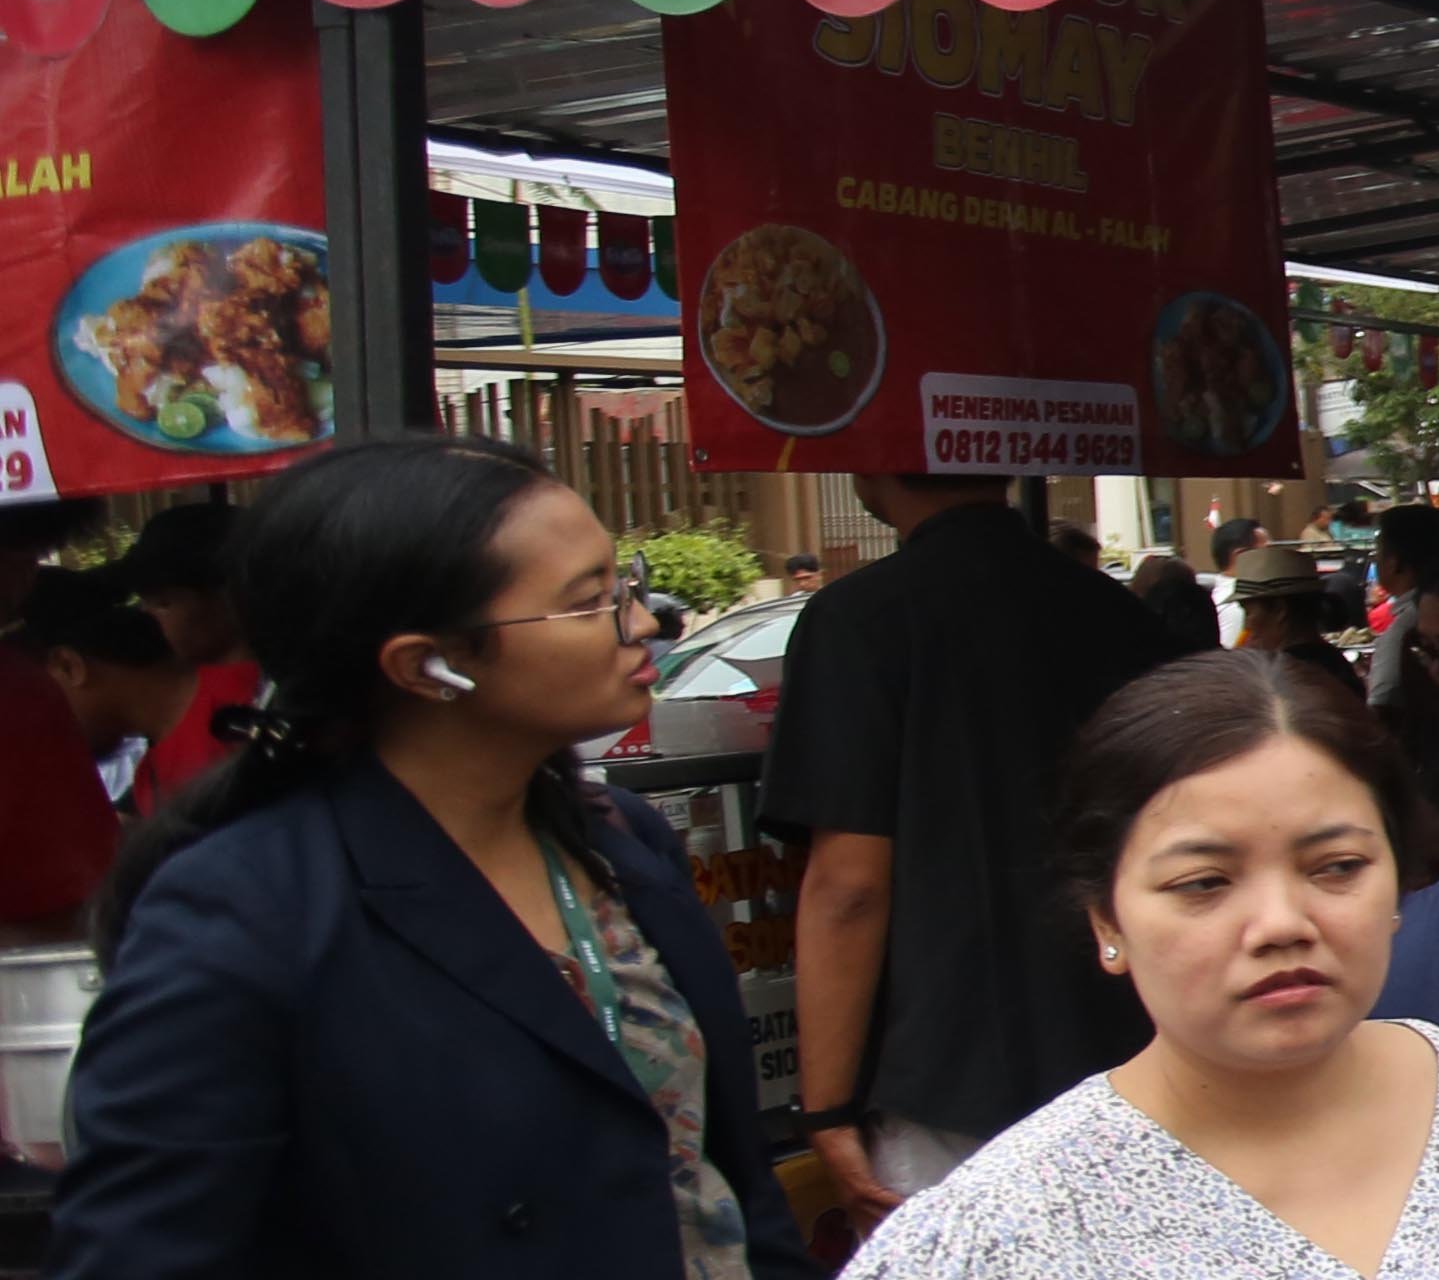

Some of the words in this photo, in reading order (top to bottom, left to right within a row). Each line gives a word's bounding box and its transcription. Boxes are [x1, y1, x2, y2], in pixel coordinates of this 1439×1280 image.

[0, 153, 91, 199] LAH
[931, 111, 1089, 195] BENHIL
[835, 175, 960, 224] CABANG
[964, 196, 1050, 236] DEPAN
[1052, 210, 1083, 242] AL
[1098, 217, 1171, 254] FALAH
[931, 394, 1040, 424] MENERIMA
[1044, 399, 1134, 427] PESANAN
[934, 429, 1001, 464] 0812
[1008, 431, 1071, 465] 1344
[1076, 434, 1134, 467] 9629
